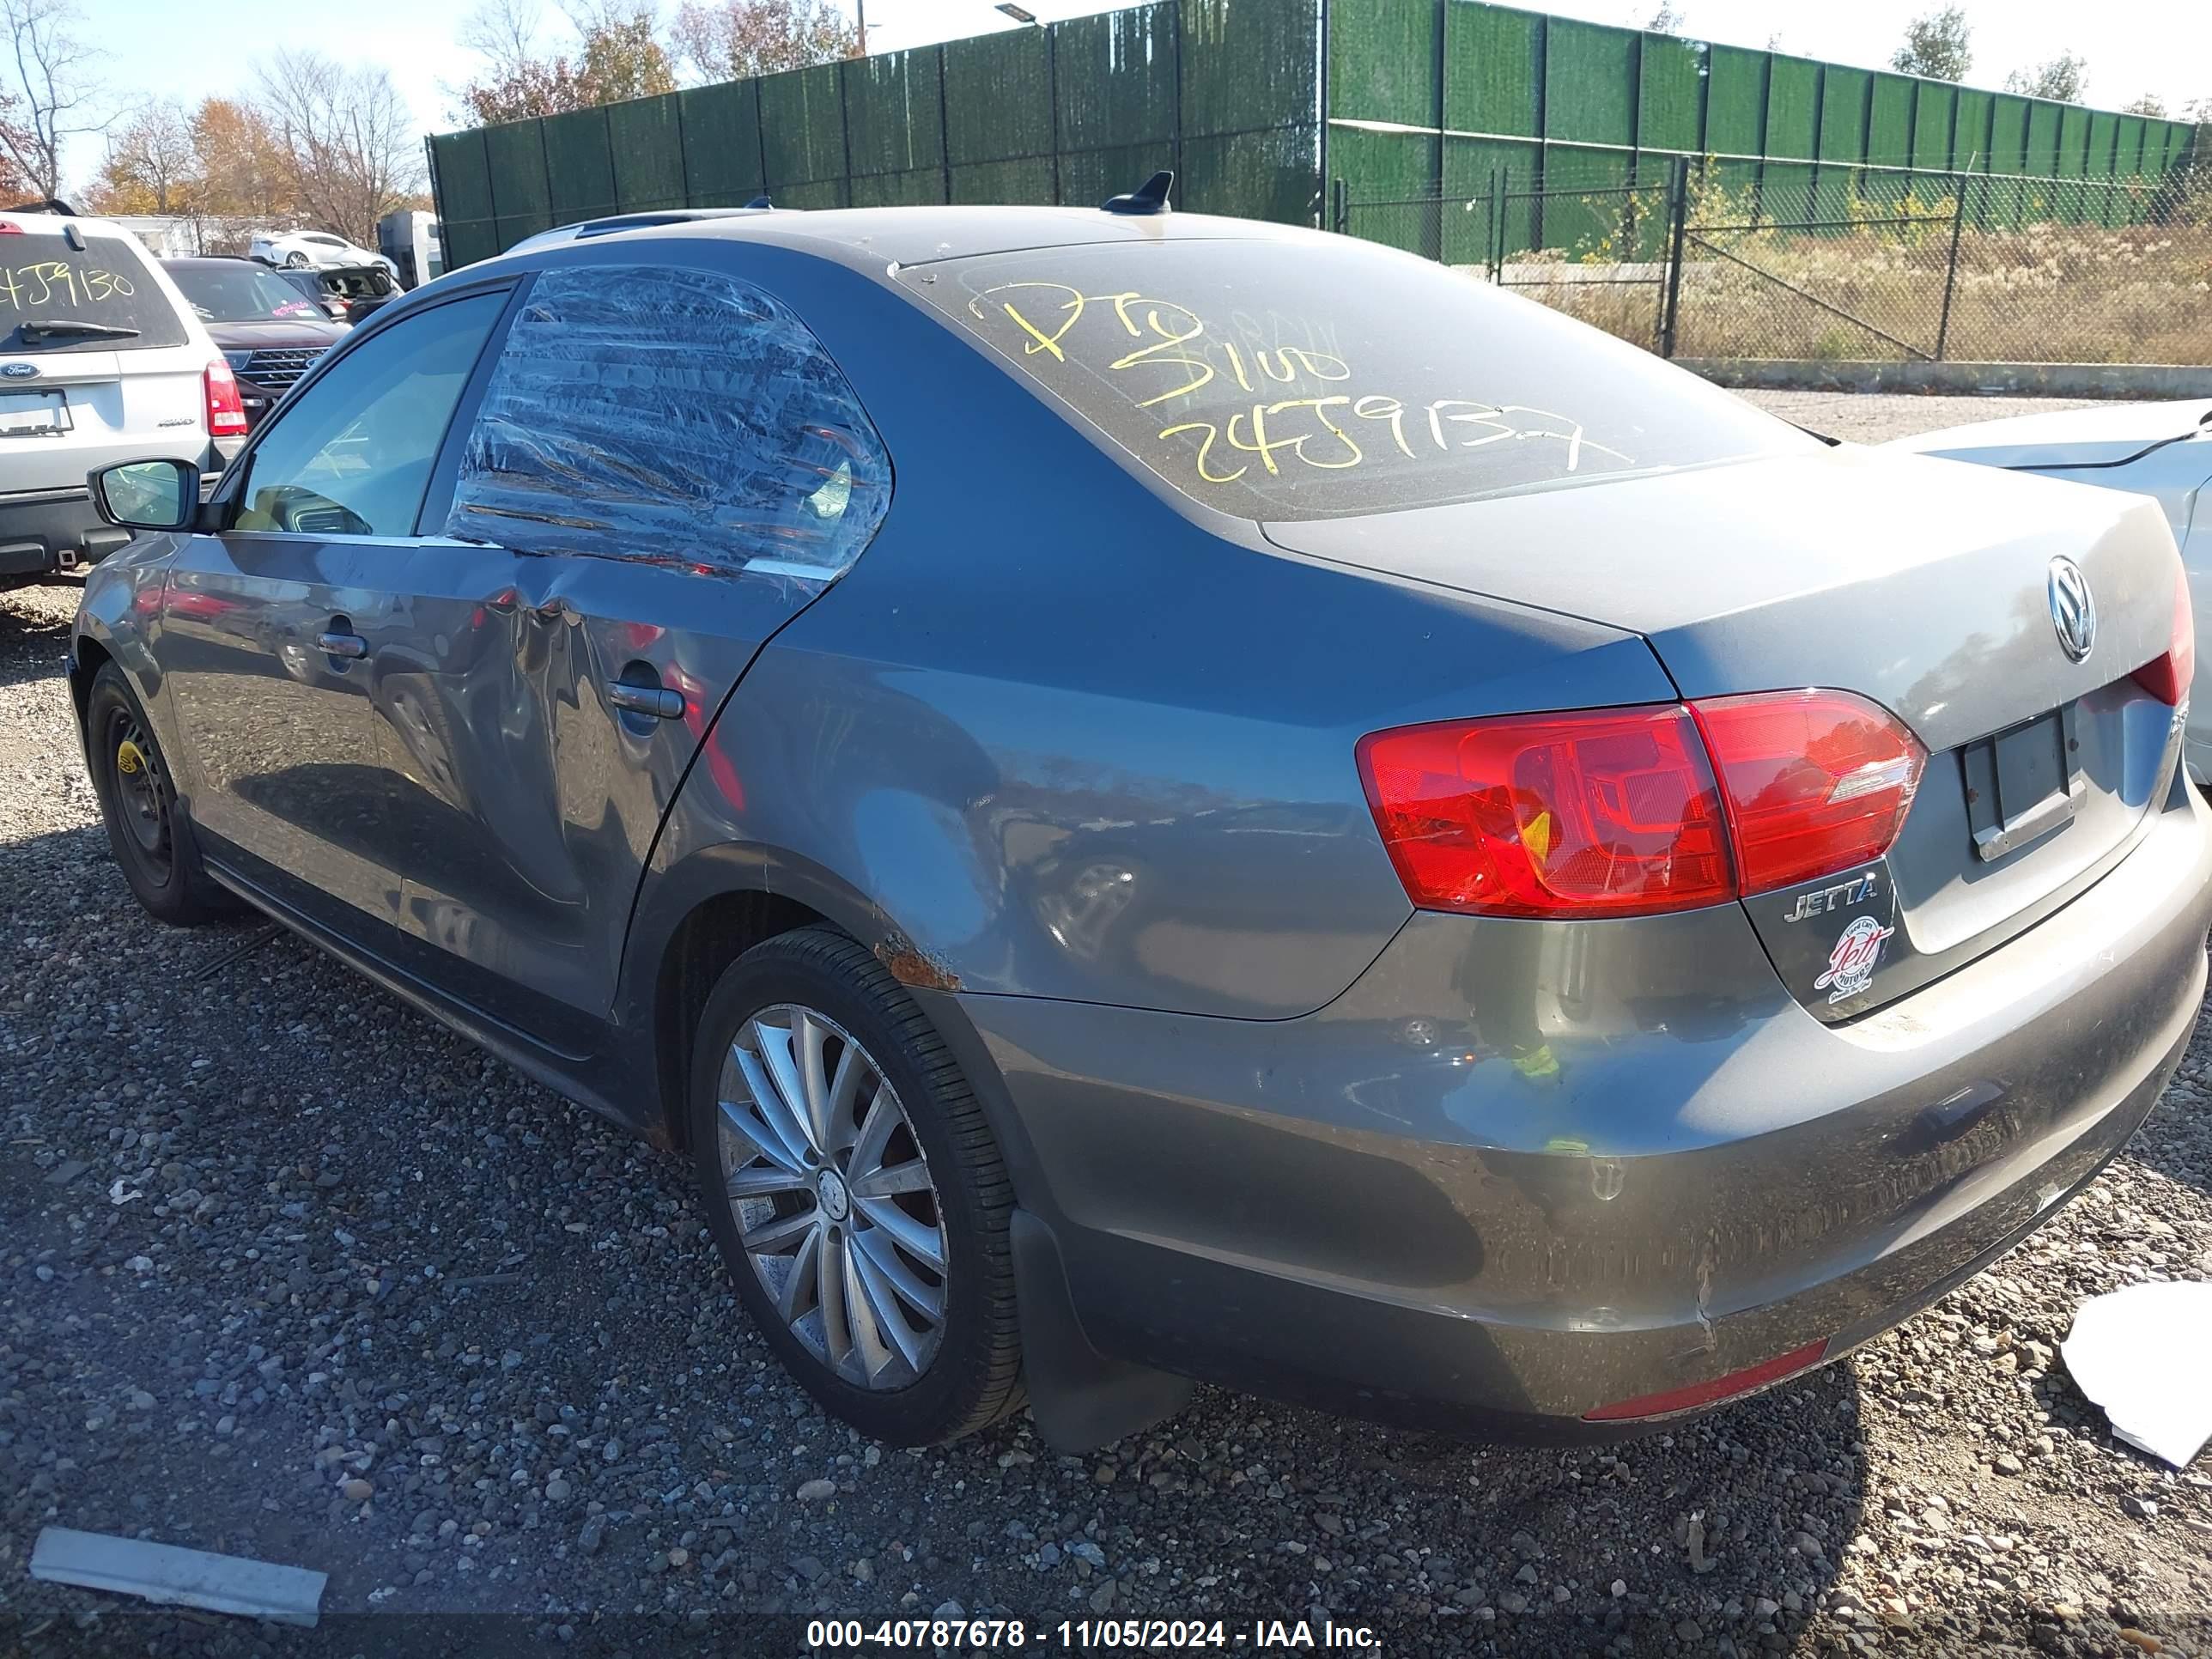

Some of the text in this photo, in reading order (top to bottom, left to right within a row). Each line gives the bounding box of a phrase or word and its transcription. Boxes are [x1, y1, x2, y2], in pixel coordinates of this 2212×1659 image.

[0, 262, 135, 310] 4J9130
[7, 364, 32, 375] Ford
[1784, 872, 1878, 923] JETTA
[1846, 921, 1874, 938] Used Cars
[1817, 929, 1894, 987] Jett
[1838, 962, 1871, 986] MOTORS
